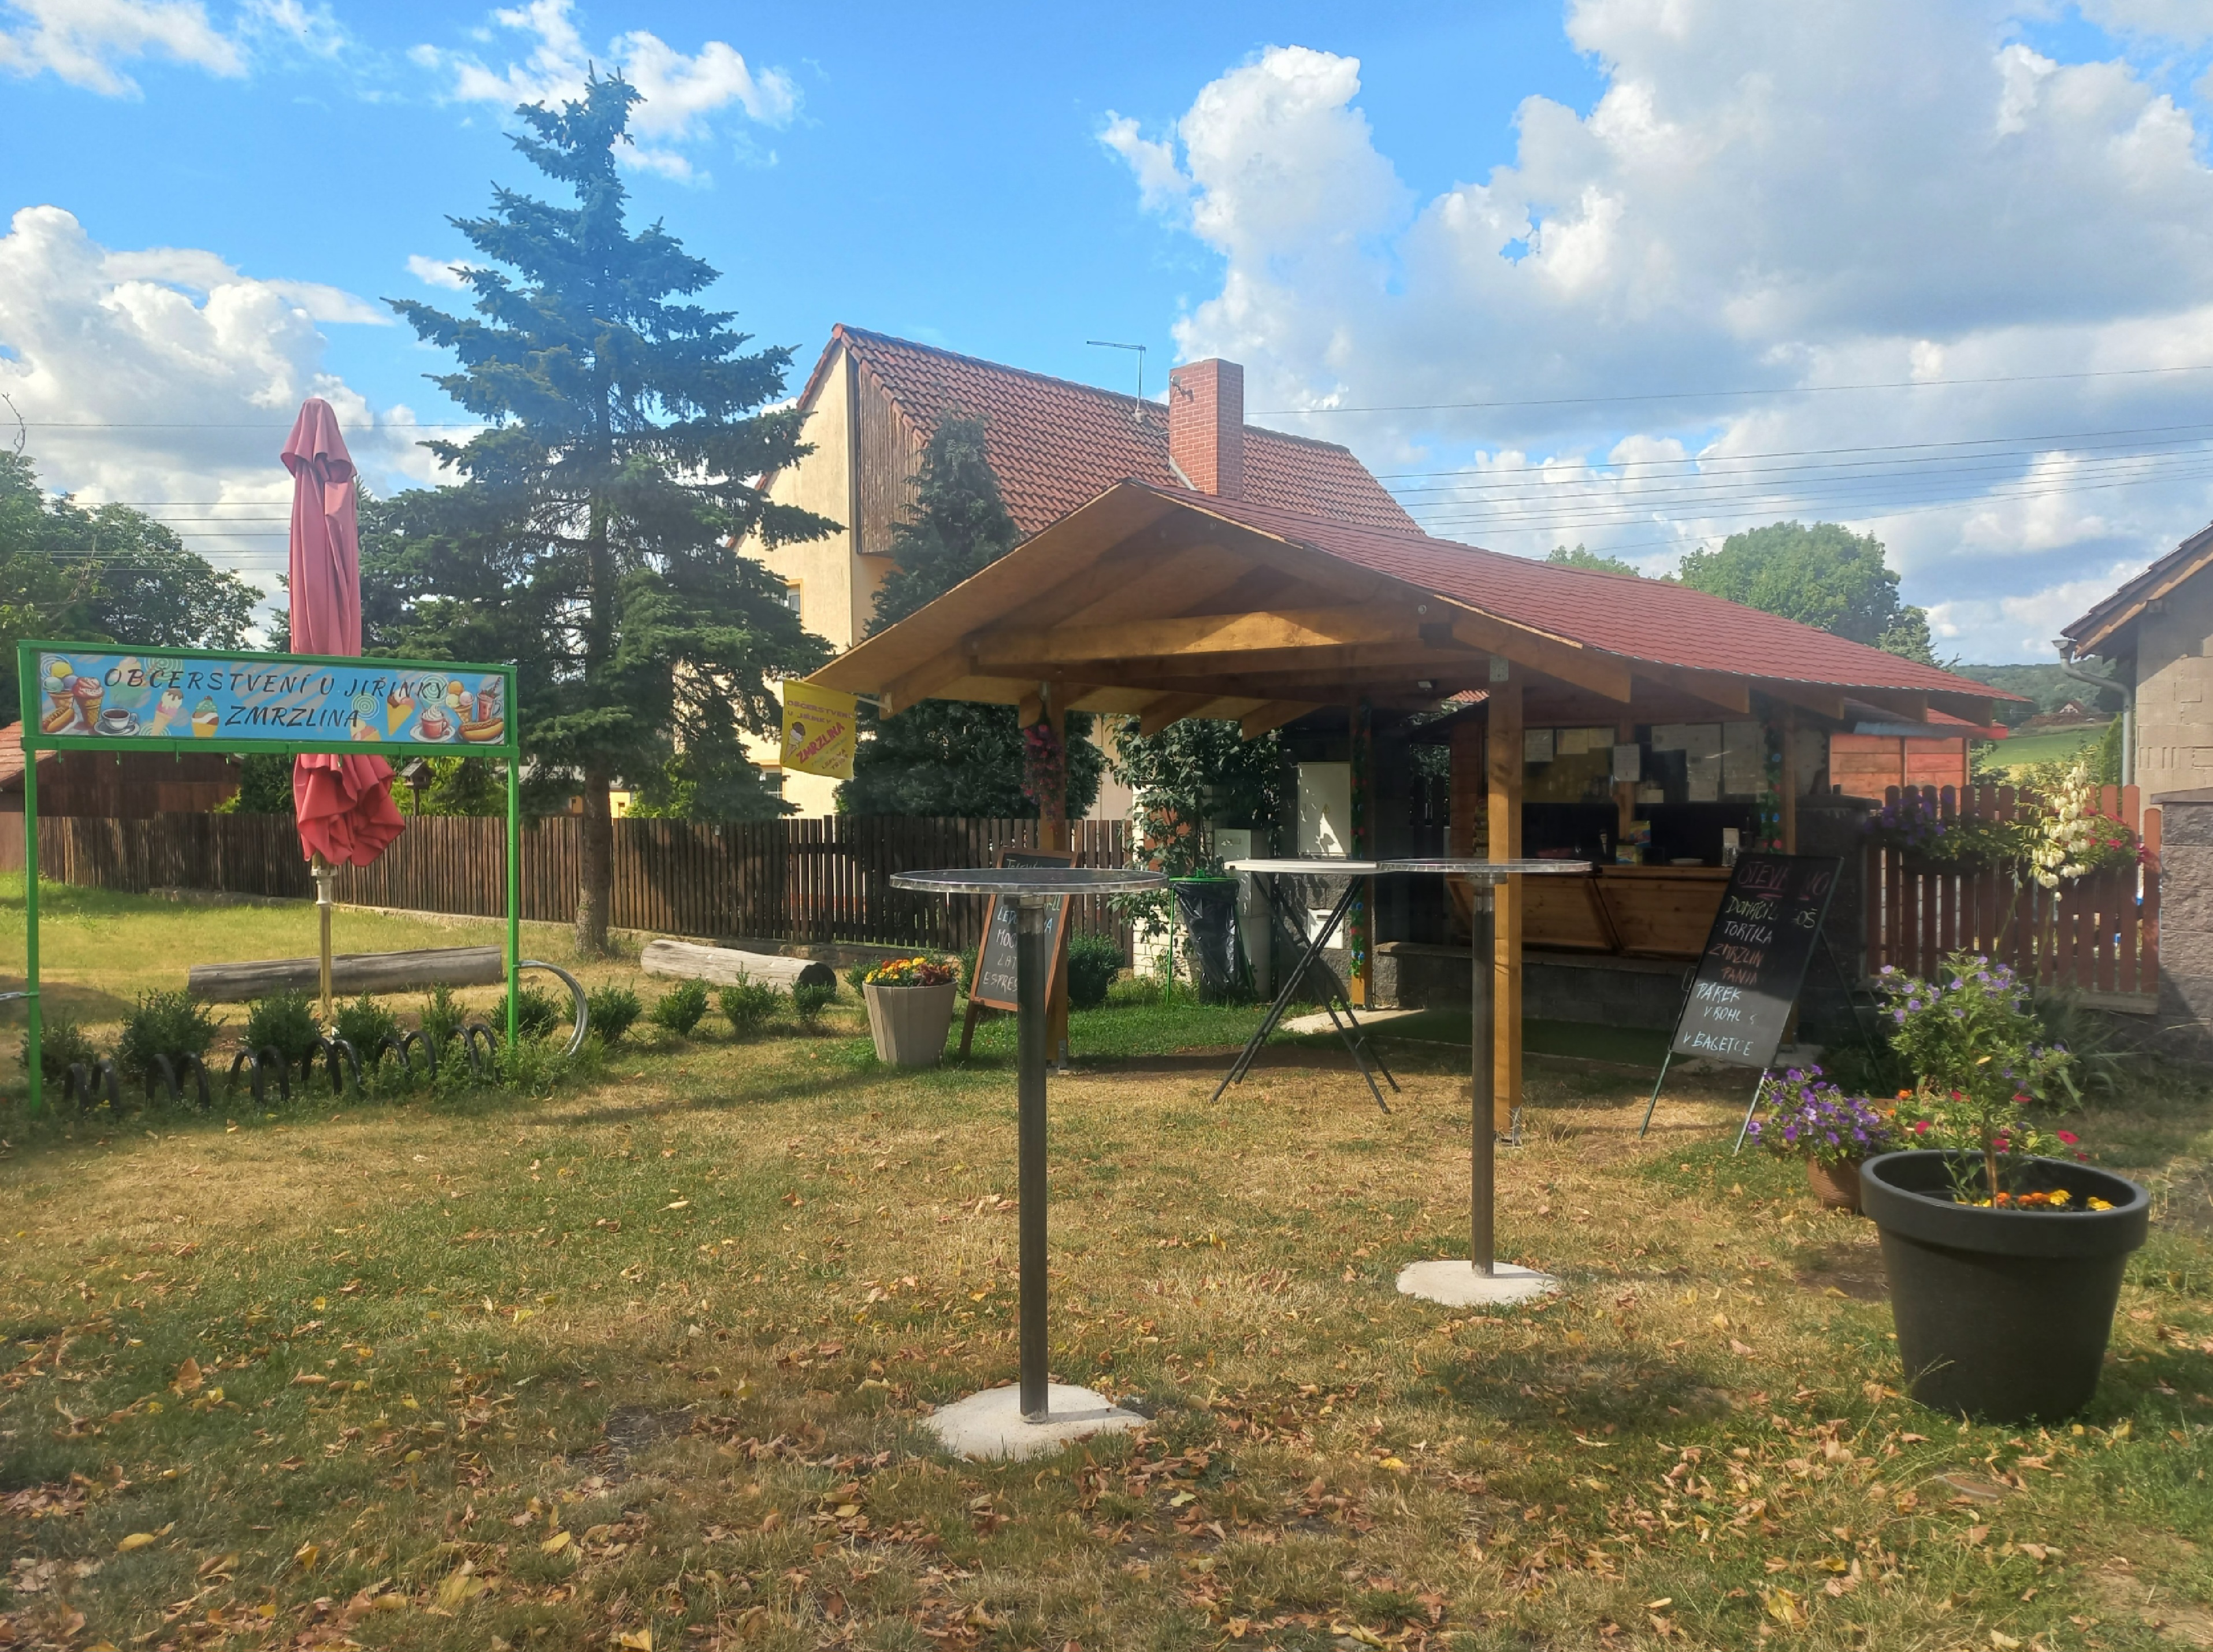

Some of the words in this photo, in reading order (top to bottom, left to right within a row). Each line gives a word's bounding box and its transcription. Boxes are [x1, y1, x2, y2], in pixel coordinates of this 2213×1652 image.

[105, 667, 311, 693] OBČERSTVENÍ
[320, 677, 335, 696] U
[344, 677, 447, 699] JIŘINKY
[225, 705, 359, 727] ZMRZLINA
[796, 722, 845, 764] ZMRZLINA
[1696, 982, 1742, 1004] PÁREK
